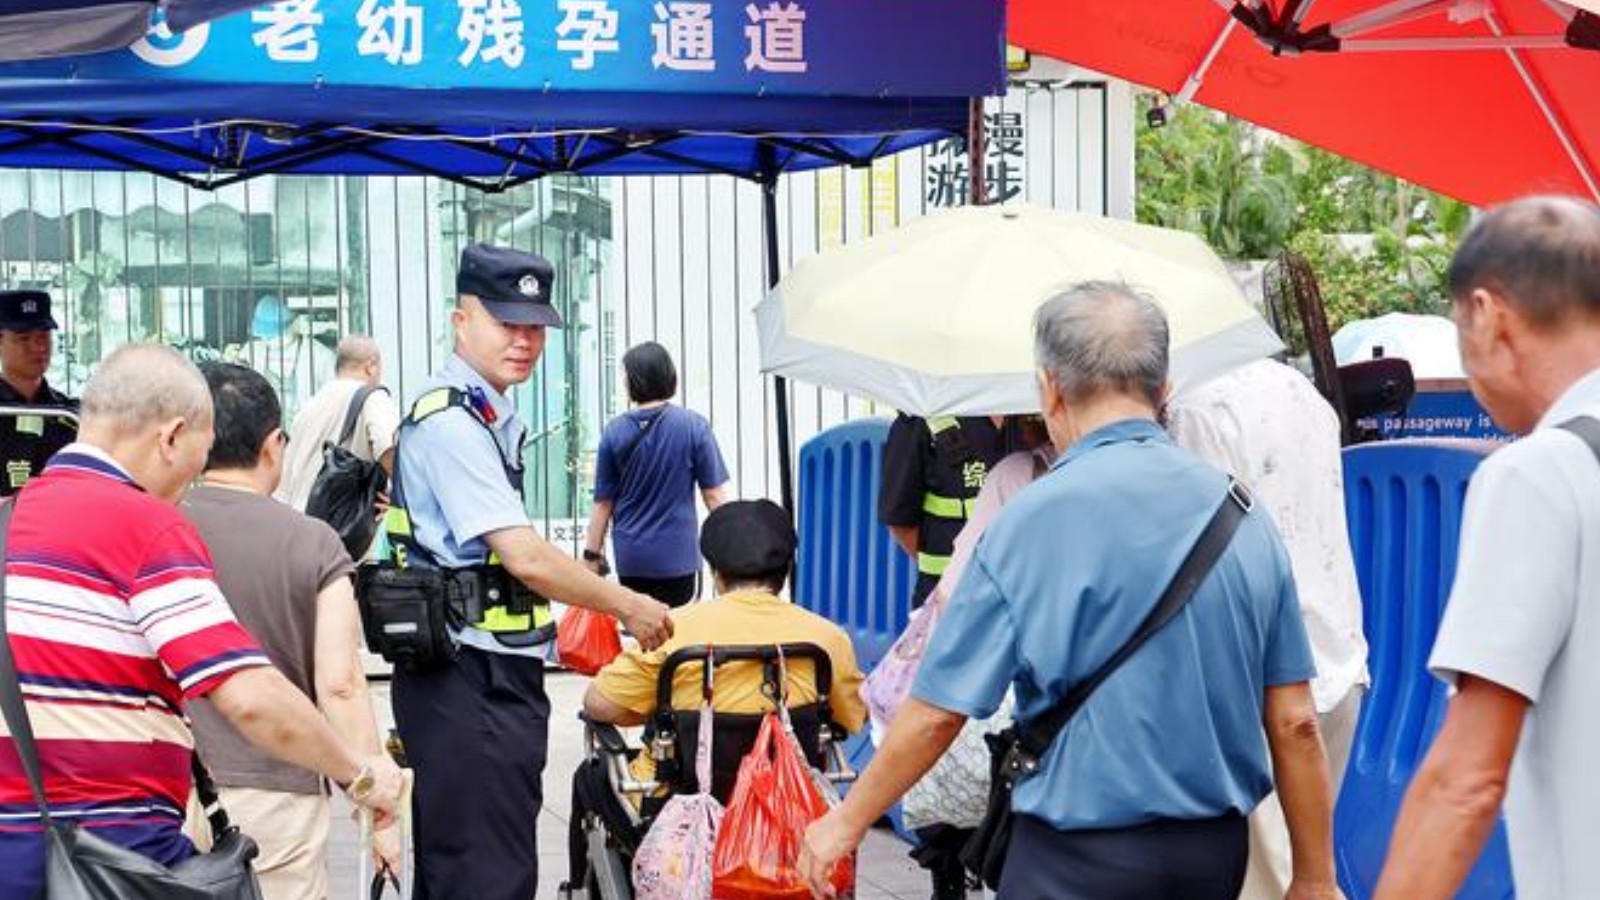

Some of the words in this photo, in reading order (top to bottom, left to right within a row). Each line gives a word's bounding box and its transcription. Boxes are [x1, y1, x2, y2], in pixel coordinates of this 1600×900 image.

[251, 0, 808, 72] 老幼残孕通道
[983, 113, 1024, 206] 漫步
[1478, 413, 1491, 427] is
